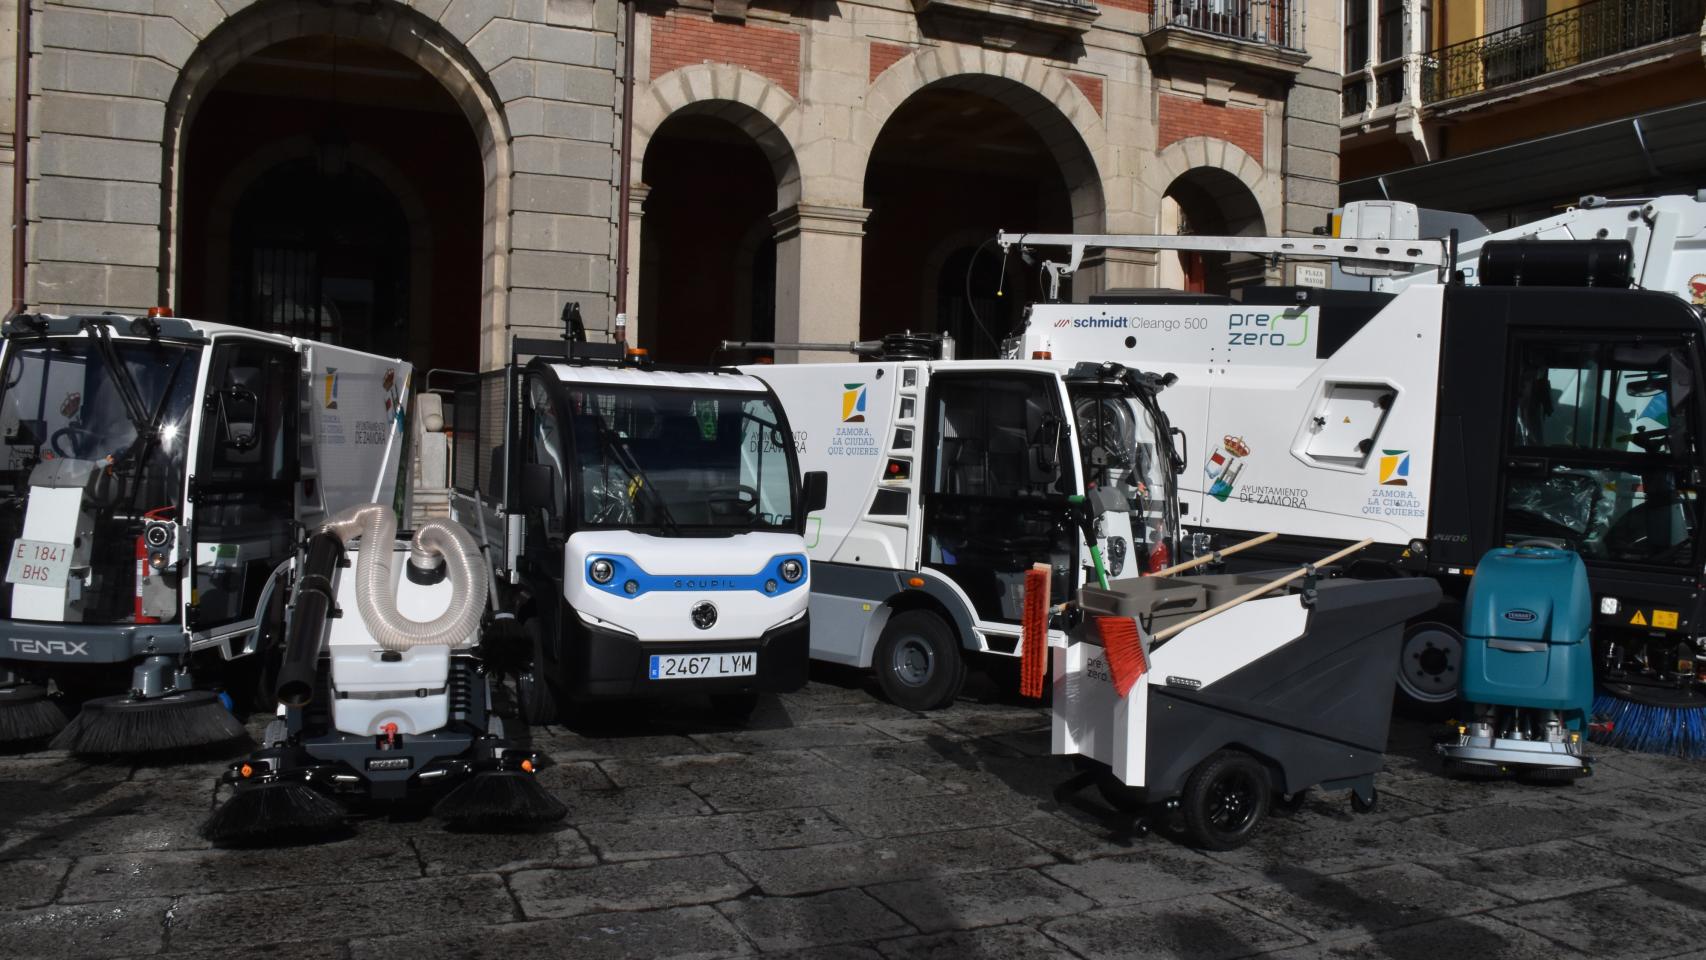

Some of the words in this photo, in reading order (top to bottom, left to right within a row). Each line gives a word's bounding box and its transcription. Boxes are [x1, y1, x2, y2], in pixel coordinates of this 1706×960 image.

[1073, 316, 1128, 328] schmidt
[1131, 316, 1181, 331] Cleango
[1184, 317, 1208, 330] 500
[1229, 313, 1270, 330] pre
[1228, 332, 1285, 346] zero
[832, 437, 842, 445] LA
[845, 437, 875, 446] CIUDAD
[828, 446, 844, 456] QUE
[846, 447, 879, 456] QUIERES
[1240, 484, 1308, 497] AYUNTAMIENTO
[1240, 493, 1253, 503] DE
[1257, 494, 1307, 508] ZAMORA
[1368, 497, 1380, 506] LA
[1382, 498, 1420, 508] CIUDAD
[1362, 506, 1381, 514] QUE
[1385, 507, 1425, 517] QUIERES
[16, 544, 27, 559] E
[34, 545, 66, 562] 1841
[22, 564, 50, 581] BHS
[674, 579, 735, 588] GOUPIL
[8, 638, 88, 655] TENAX
[665, 657, 711, 676] 2467
[719, 654, 752, 673] LYM
